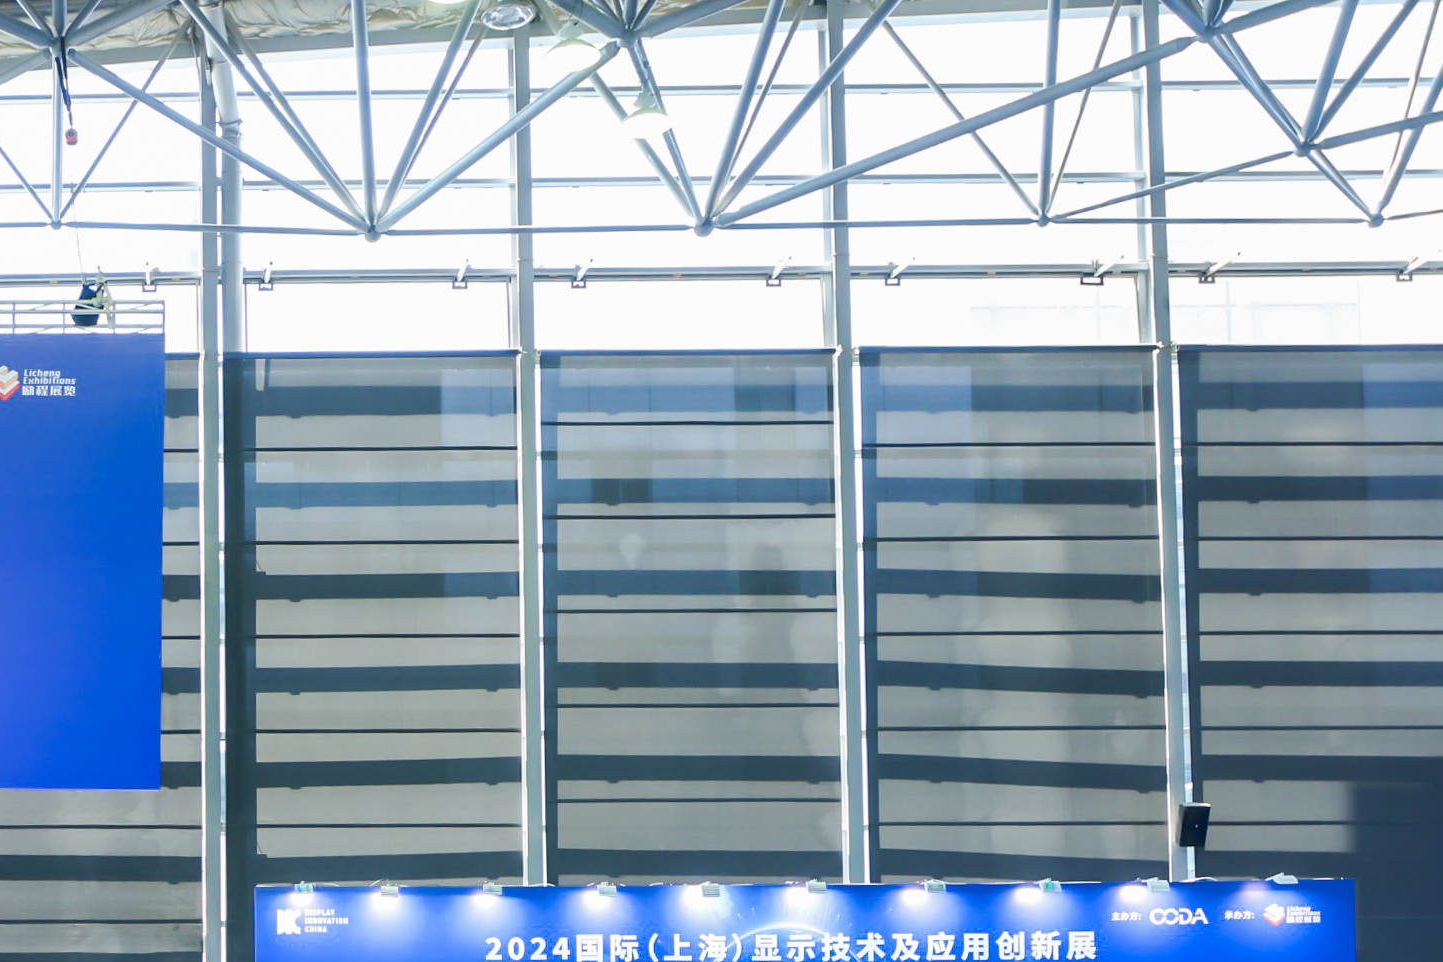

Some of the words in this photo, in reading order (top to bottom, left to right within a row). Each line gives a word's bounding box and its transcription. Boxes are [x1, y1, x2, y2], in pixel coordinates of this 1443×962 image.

[23, 369, 61, 379] Licheng
[23, 376, 76, 385] Exhibitions
[1149, 907, 1209, 925] CODA
[485, 931, 1097, 962] 2024国际（上海）显示技术及应用创新展
